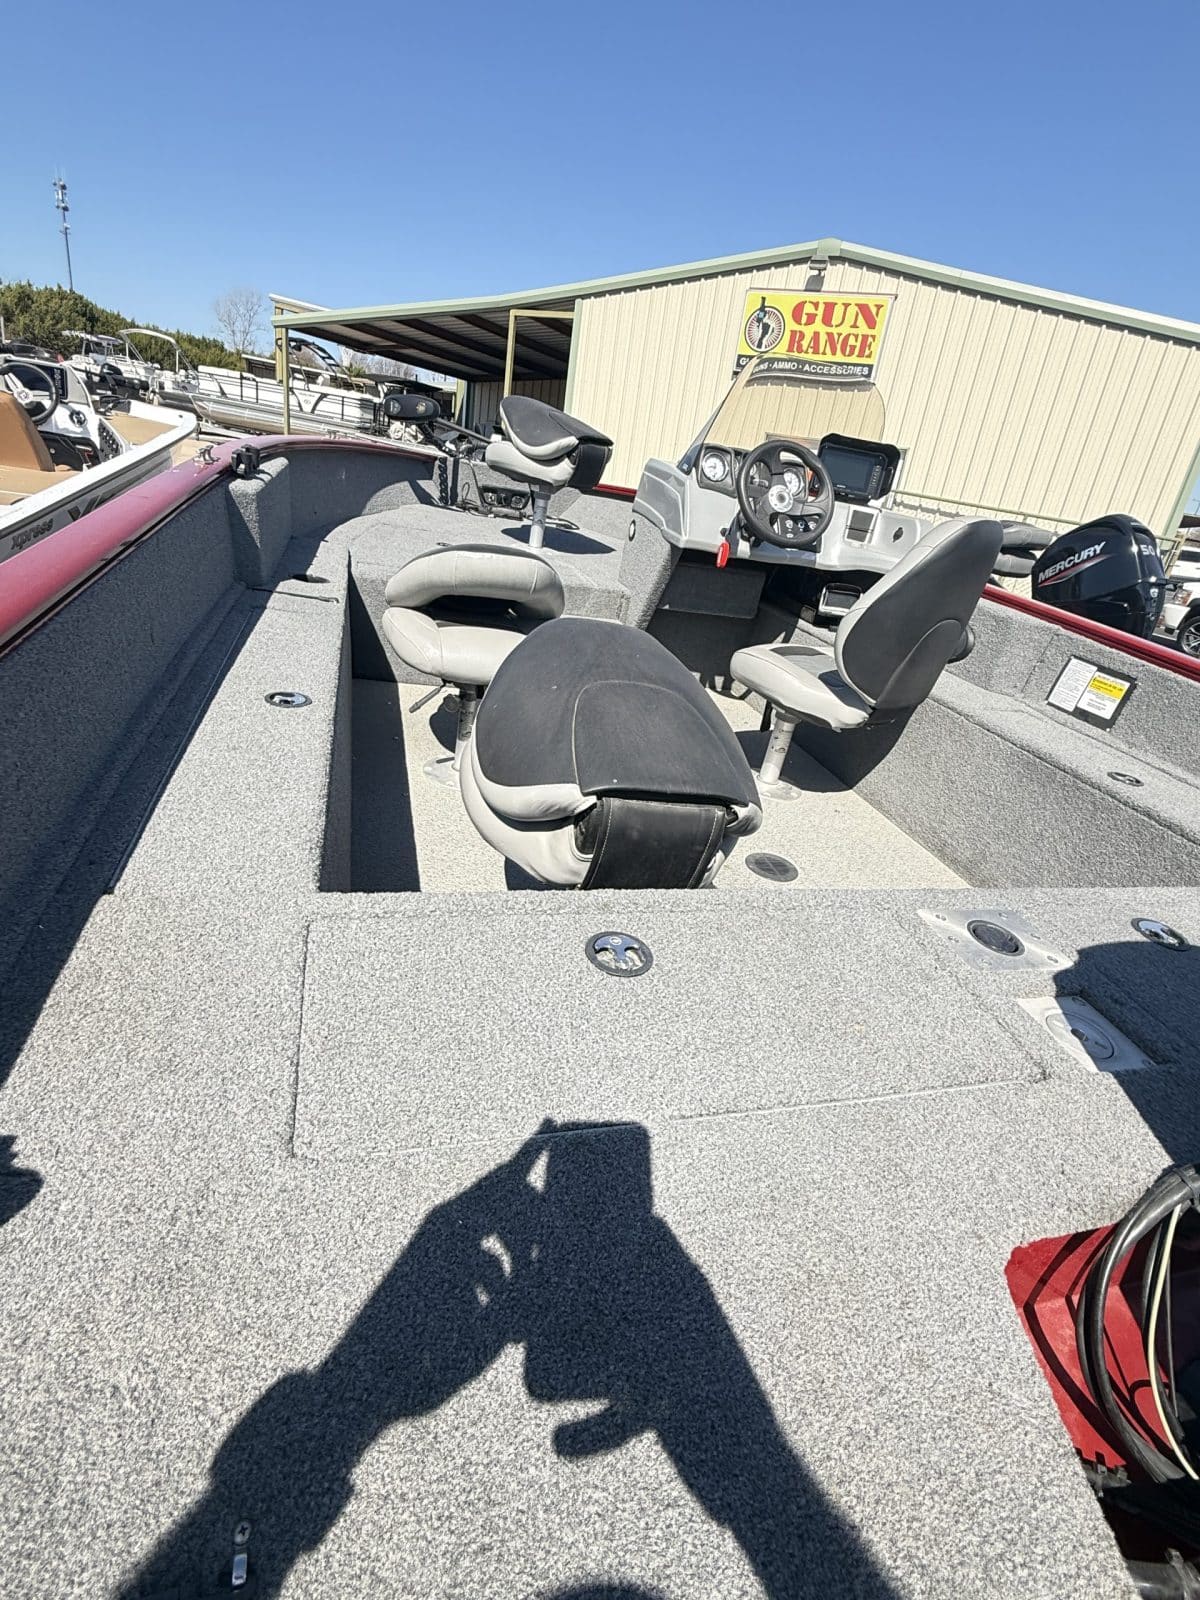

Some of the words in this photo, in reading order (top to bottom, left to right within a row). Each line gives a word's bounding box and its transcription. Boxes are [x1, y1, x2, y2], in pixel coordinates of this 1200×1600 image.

[791, 300, 885, 330] GUN
[785, 329, 877, 359] RANGE
[771, 360, 798, 371] AMMO
[803, 363, 870, 376] ACCESSORIES
[1038, 541, 1107, 584] MERCURY
[1140, 544, 1156, 557] 50
